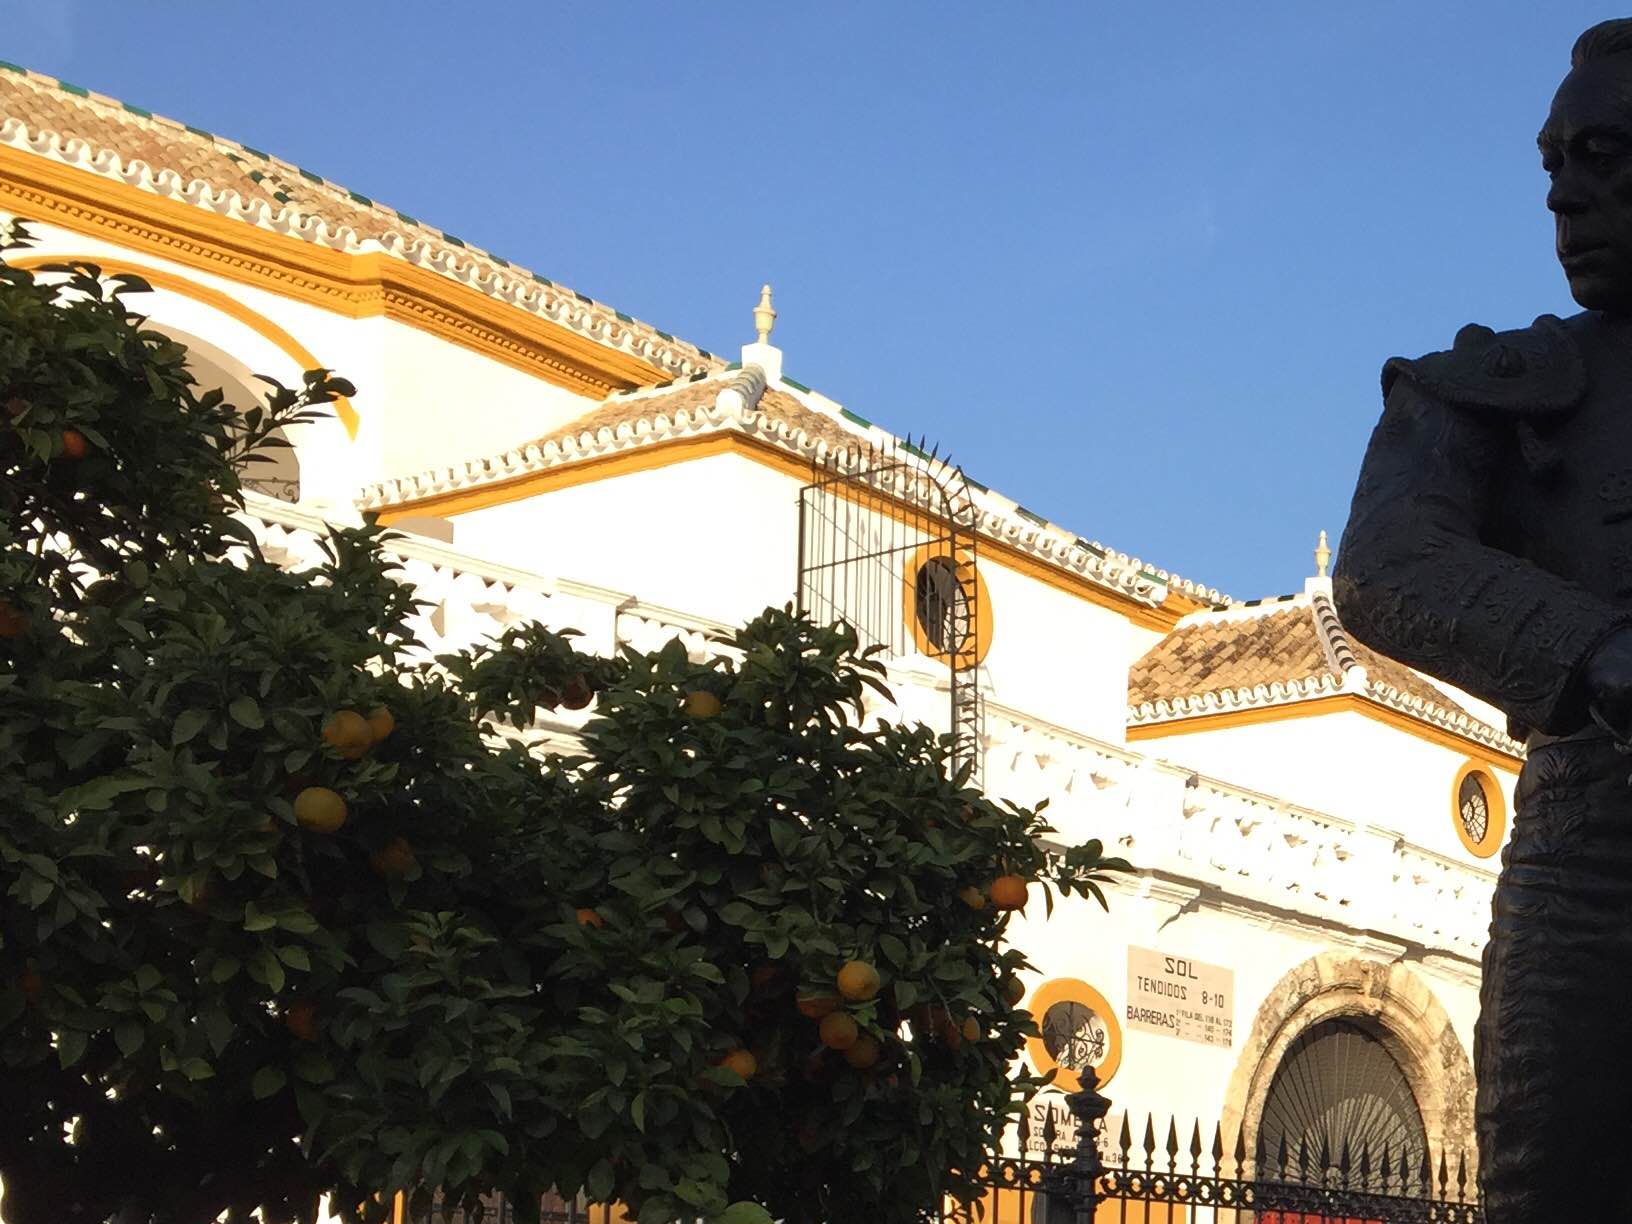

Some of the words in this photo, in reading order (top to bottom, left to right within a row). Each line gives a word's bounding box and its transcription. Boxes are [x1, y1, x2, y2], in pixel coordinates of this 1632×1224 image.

[1164, 956, 1199, 980] SOL
[1137, 975, 1188, 1001] TENDIDOS
[1201, 990, 1225, 1009] 8-10
[1126, 1005, 1176, 1029] BARRERAS
